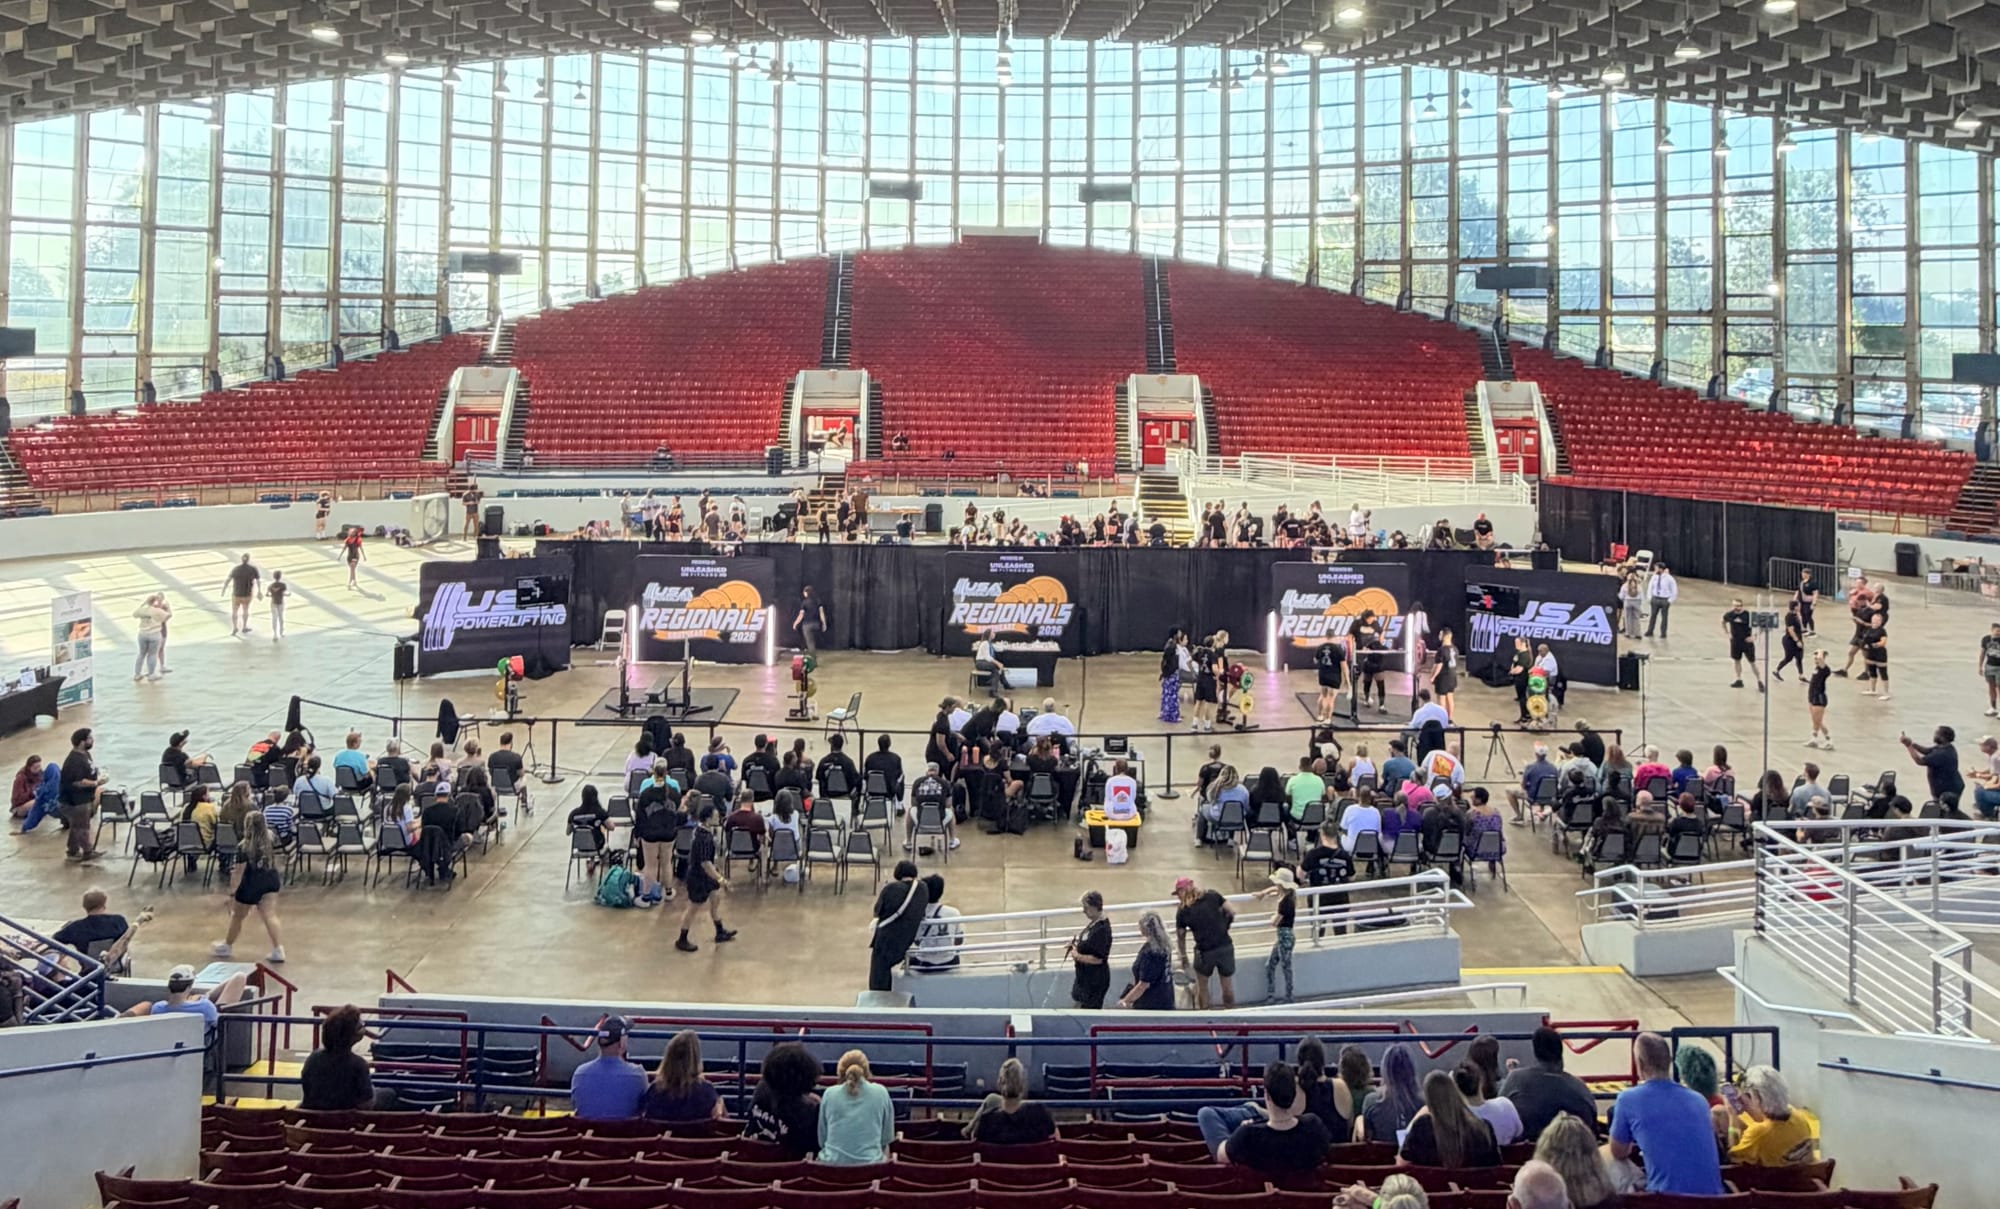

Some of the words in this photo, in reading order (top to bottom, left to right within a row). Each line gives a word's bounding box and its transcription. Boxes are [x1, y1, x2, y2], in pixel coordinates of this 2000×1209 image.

[453, 612, 567, 630] POWERLIFTING
[639, 608, 768, 631] REGIONALS
[948, 603, 1075, 625] REGIONALS
[729, 631, 757, 643] 2026
[1037, 625, 1063, 637] 2026
[1500, 623, 1614, 645] POWERLIFTING
